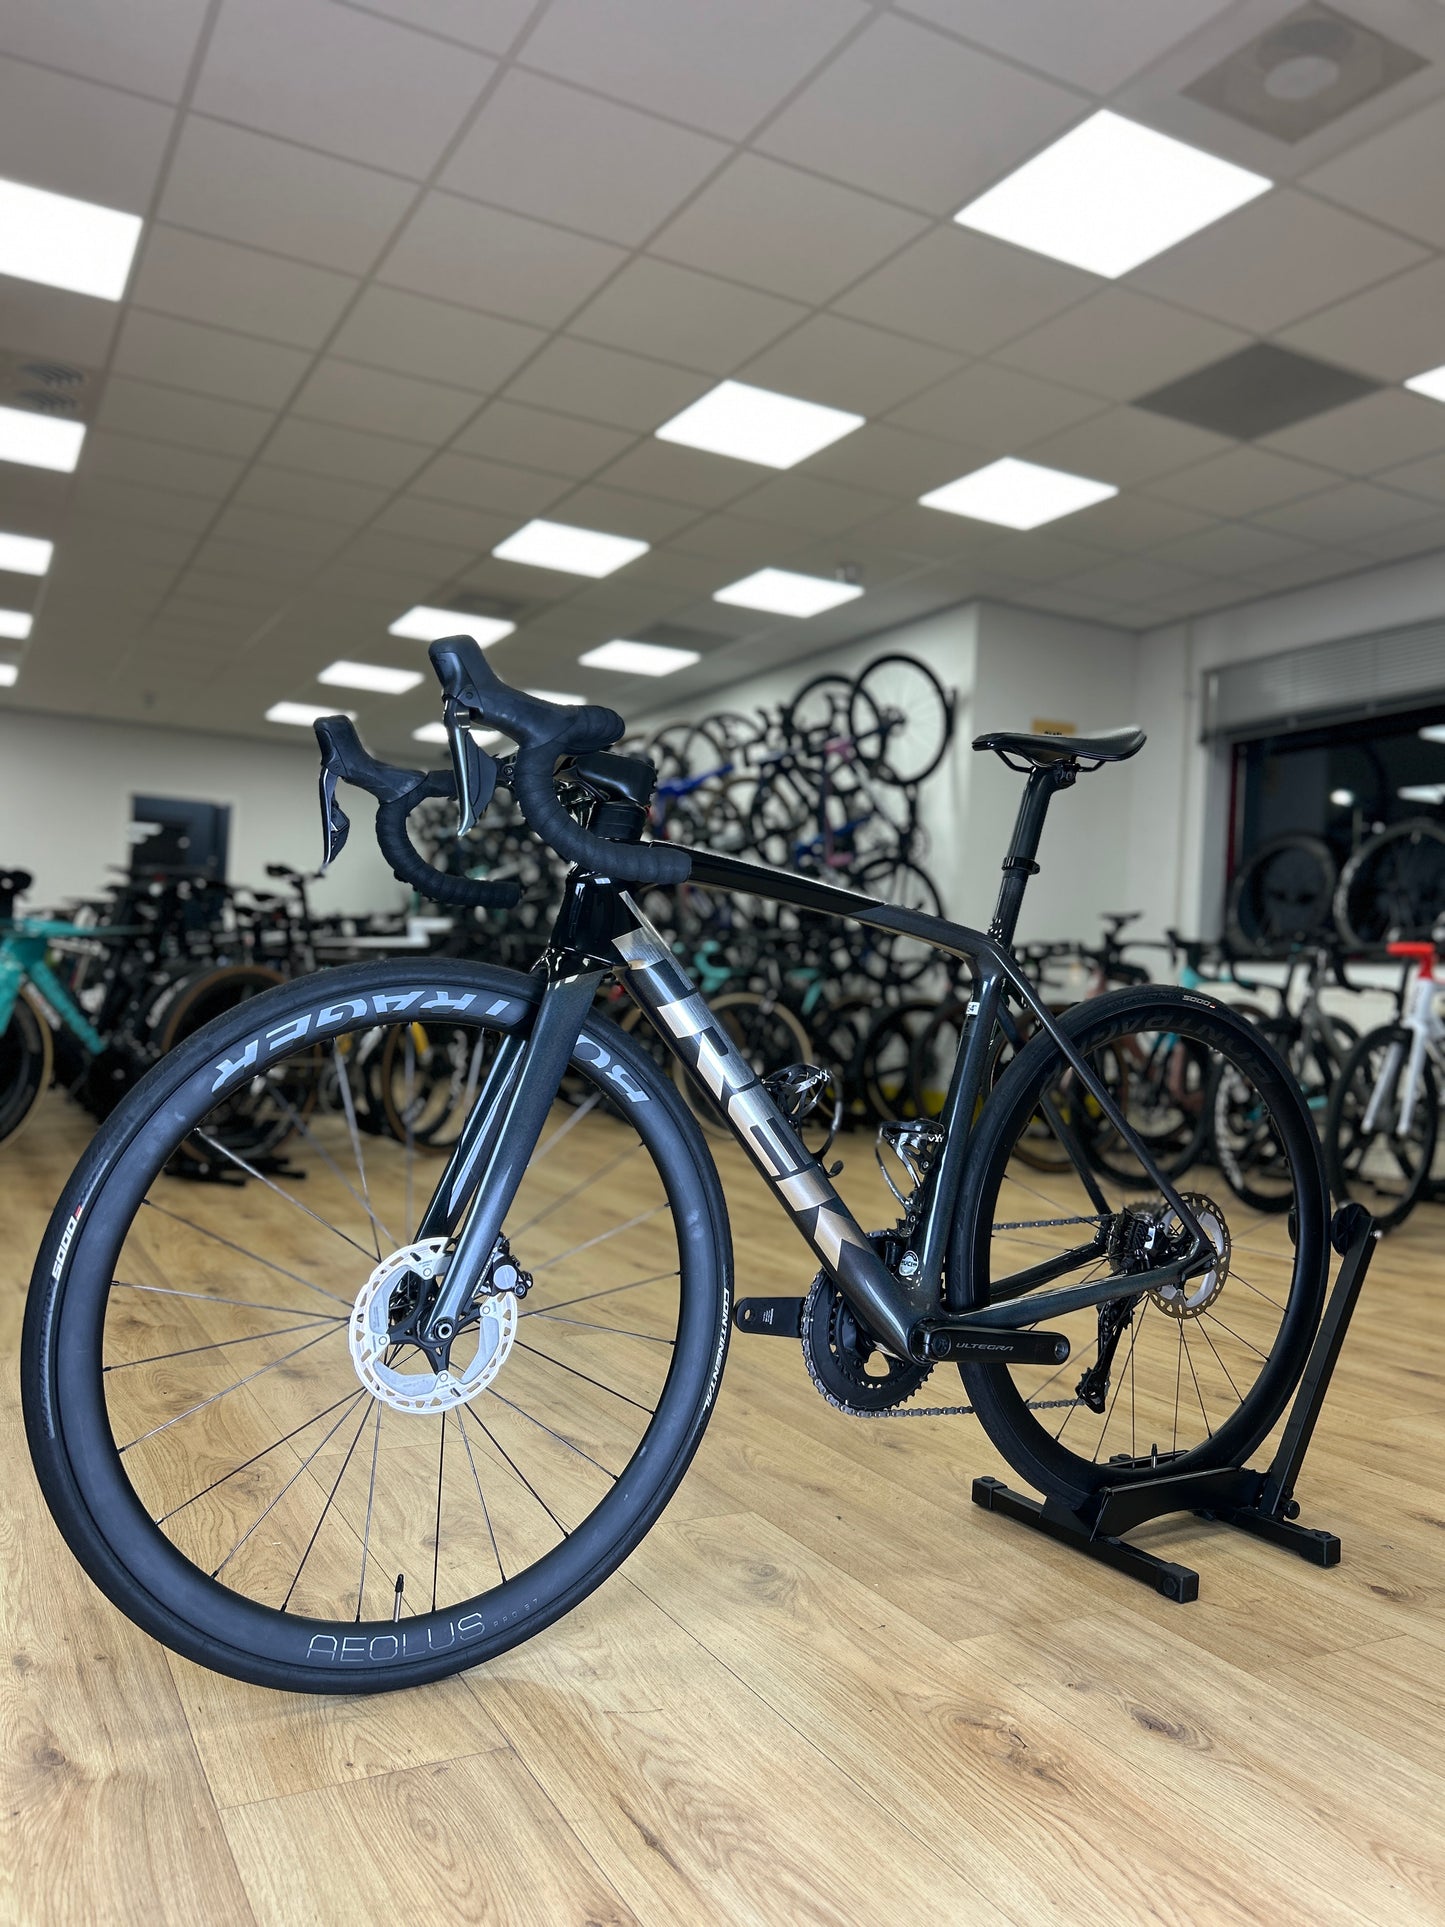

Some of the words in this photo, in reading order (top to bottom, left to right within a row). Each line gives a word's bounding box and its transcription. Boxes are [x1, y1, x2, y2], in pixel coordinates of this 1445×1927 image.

[211, 990, 650, 1103] BOTRAGER
[611, 890, 877, 1271] TREK
[51, 1216, 75, 1282] 5000
[702, 1287, 730, 1411] CONTINENTAL
[955, 1342, 1014, 1352] ULTEGRA
[306, 1612, 485, 1662] AEOLUS
